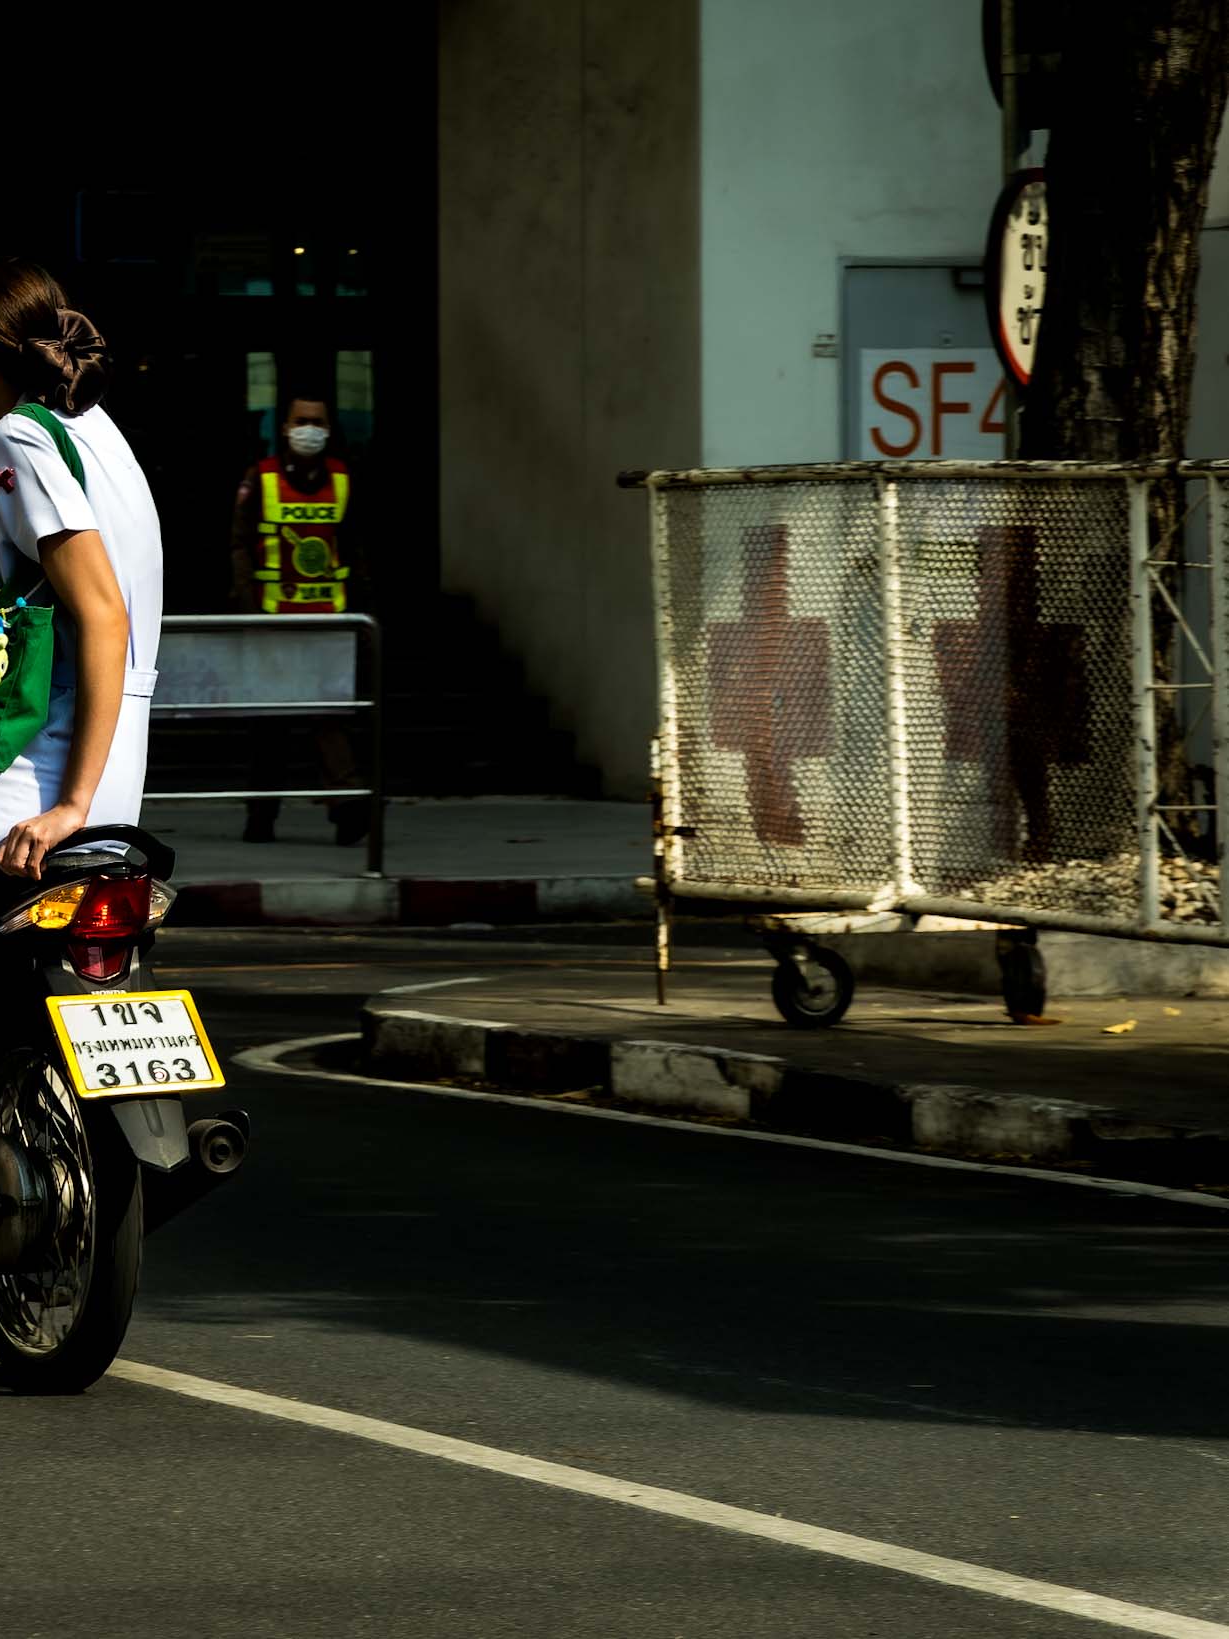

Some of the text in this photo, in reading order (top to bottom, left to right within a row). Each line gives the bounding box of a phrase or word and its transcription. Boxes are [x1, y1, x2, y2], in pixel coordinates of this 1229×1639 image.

[281, 506, 336, 520] POLICE
[72, 1034, 200, 1058] กรุงเทพมหานคร
[96, 1058, 196, 1088] 3163
